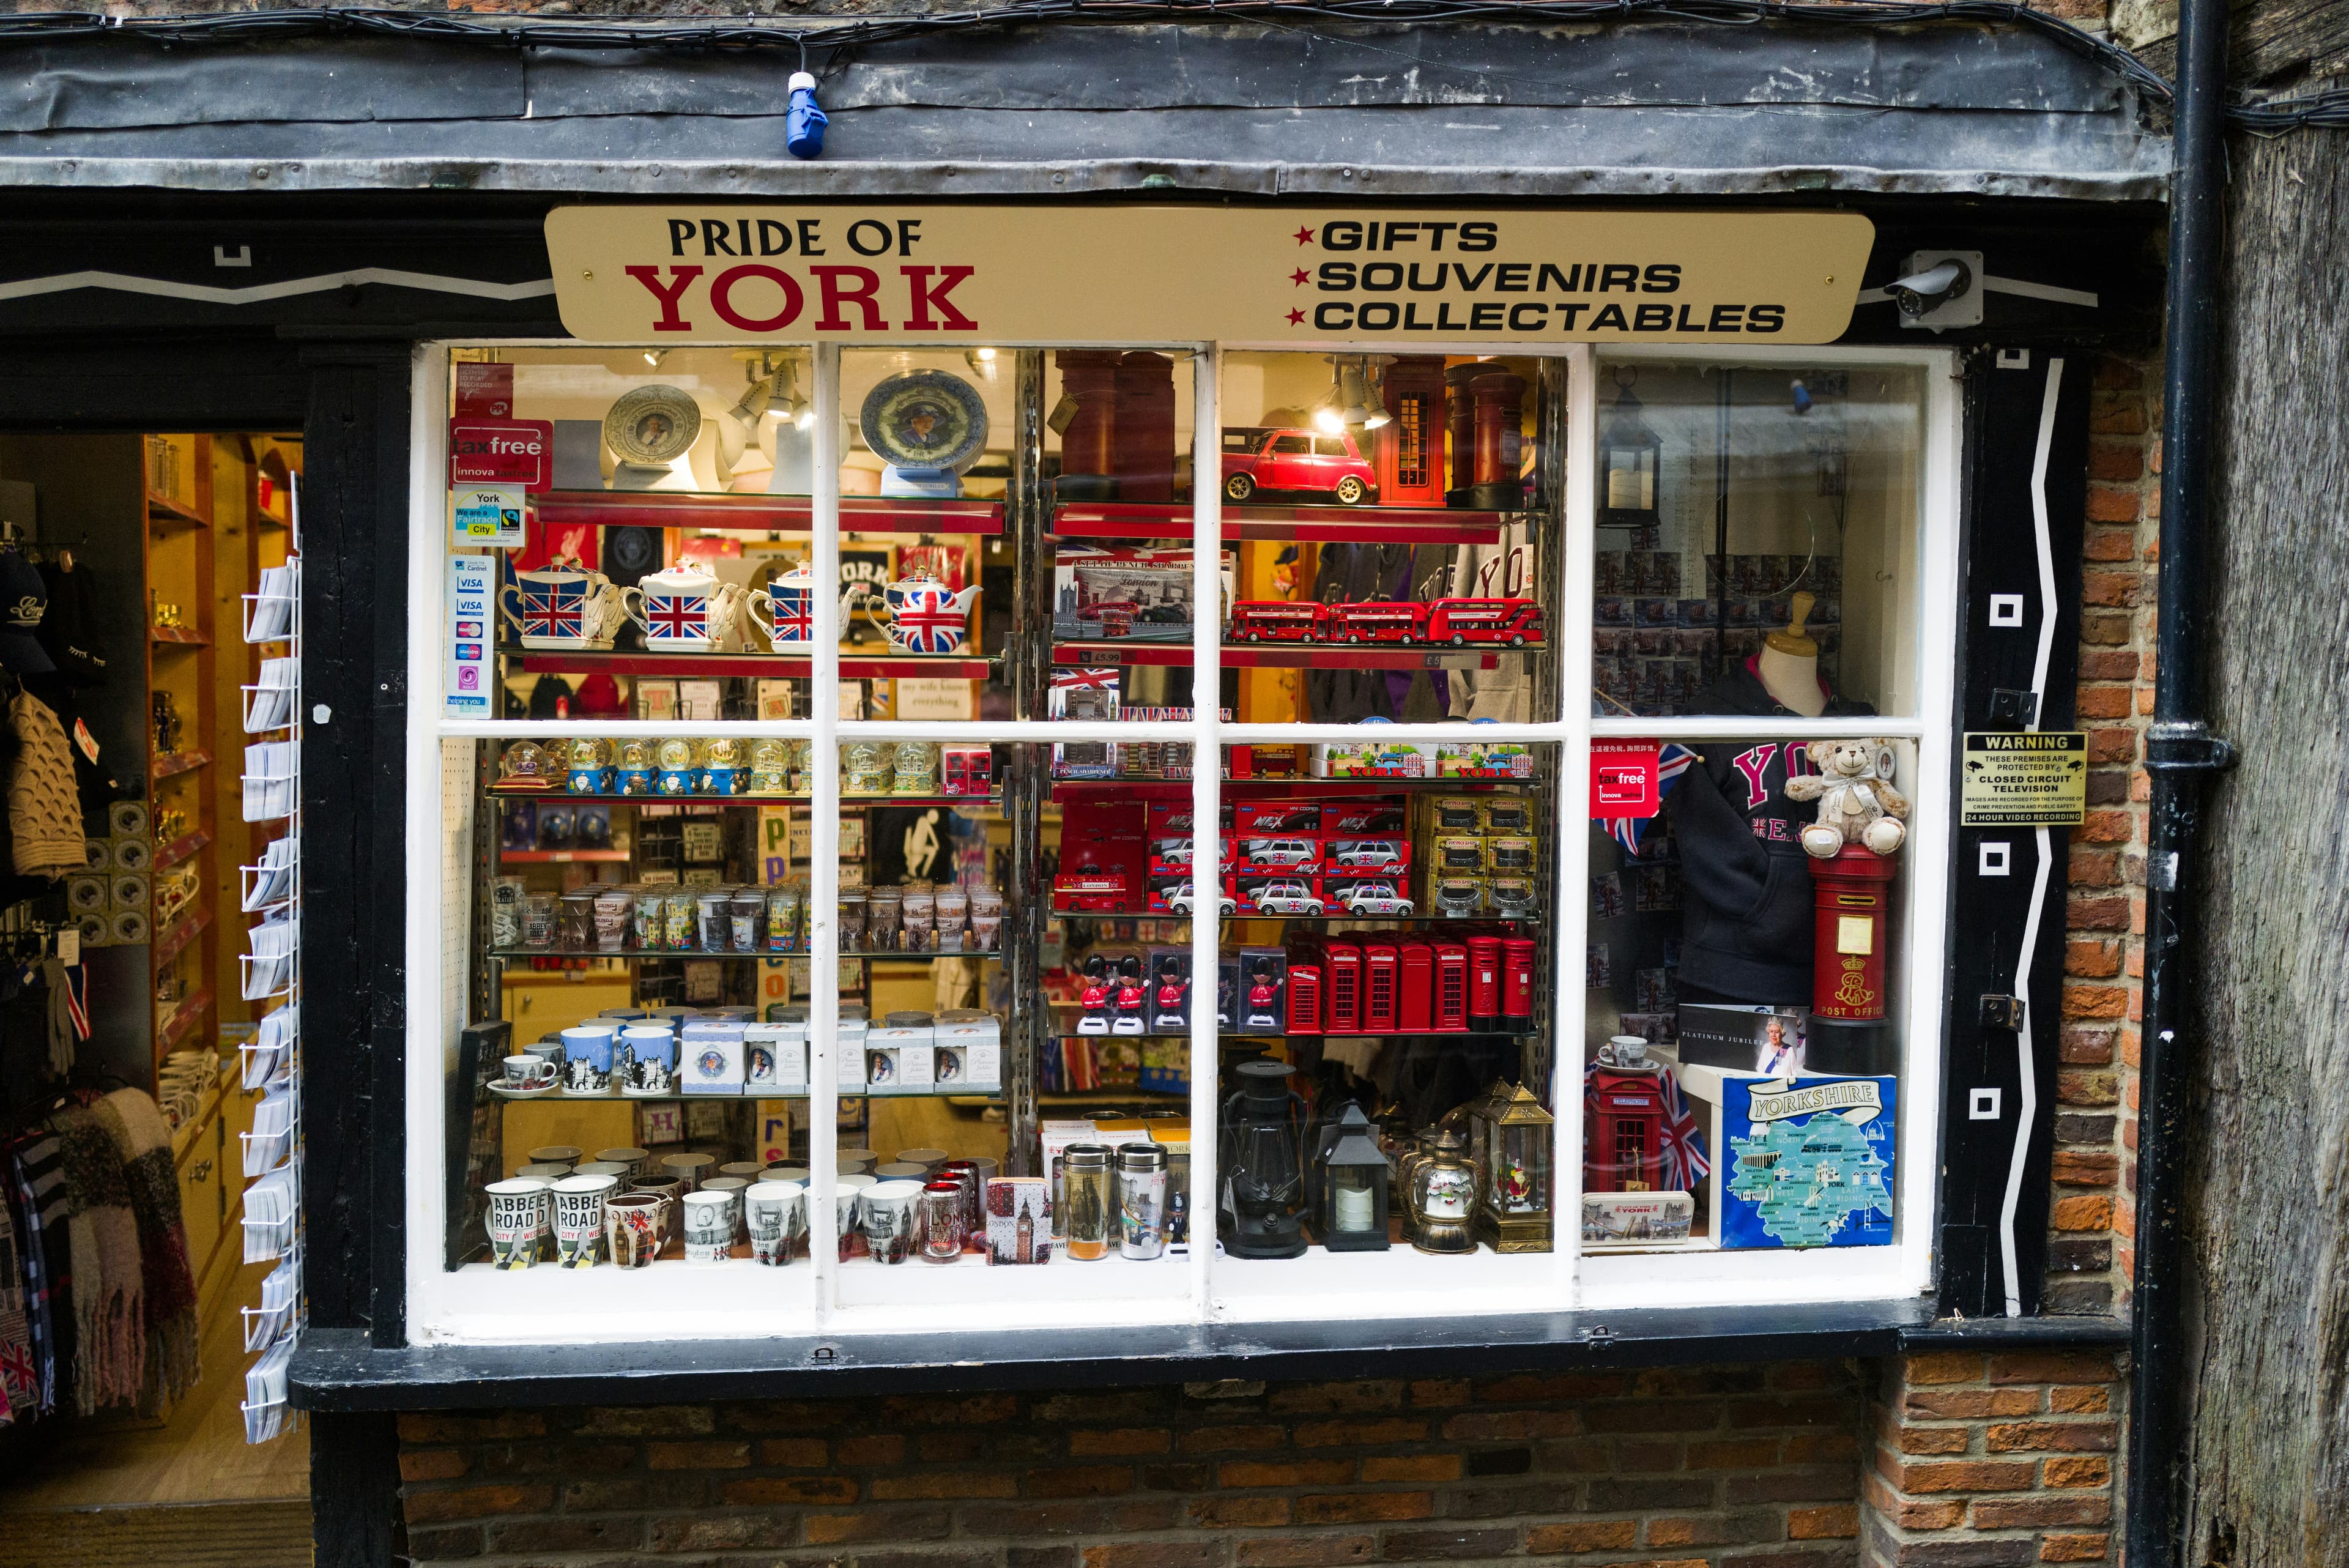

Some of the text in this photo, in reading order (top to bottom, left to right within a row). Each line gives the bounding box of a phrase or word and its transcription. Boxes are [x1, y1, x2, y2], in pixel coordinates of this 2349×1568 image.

[667, 219, 922, 256] PRIDE OF
[1321, 221, 1497, 251] GIFTS
[1317, 262, 1682, 292] SOUVENIRS
[625, 264, 978, 332] YORK
[1313, 302, 1786, 332] COLLECTABLES
[452, 437, 542, 455] taxfree
[458, 467, 536, 478] innova taxfree
[477, 494, 500, 503] York
[457, 515, 499, 524] Fairtrade
[473, 526, 491, 535] City
[461, 579, 483, 587] VISA
[1119, 573, 1158, 587] London
[461, 601, 483, 610] VISA
[1095, 653, 1119, 662] £5.99
[919, 682, 938, 691] wife
[448, 697, 469, 705] helping
[911, 697, 959, 708] everything
[1986, 736, 2068, 749] WARNING
[1346, 766, 1407, 778] YORK
[1456, 767, 1515, 778] YORK
[1599, 772, 1646, 784] taxfree
[1252, 814, 1286, 829] NEX
[1337, 816, 1370, 830] NEX
[1295, 863, 1321, 874] NEX
[1381, 863, 1408, 875] NEX
[1821, 1006, 1846, 1016] POST
[1682, 1031, 1764, 1046] PLATINUM JUBILEE
[1754, 1085, 1874, 1118] YORKSHIRE
[494, 1195, 540, 1212] ABBEY
[560, 1194, 604, 1210] ABBEY
[495, 1213, 533, 1228] ROAD
[561, 1211, 598, 1227] ROAD
[495, 1232, 510, 1241] CITY
